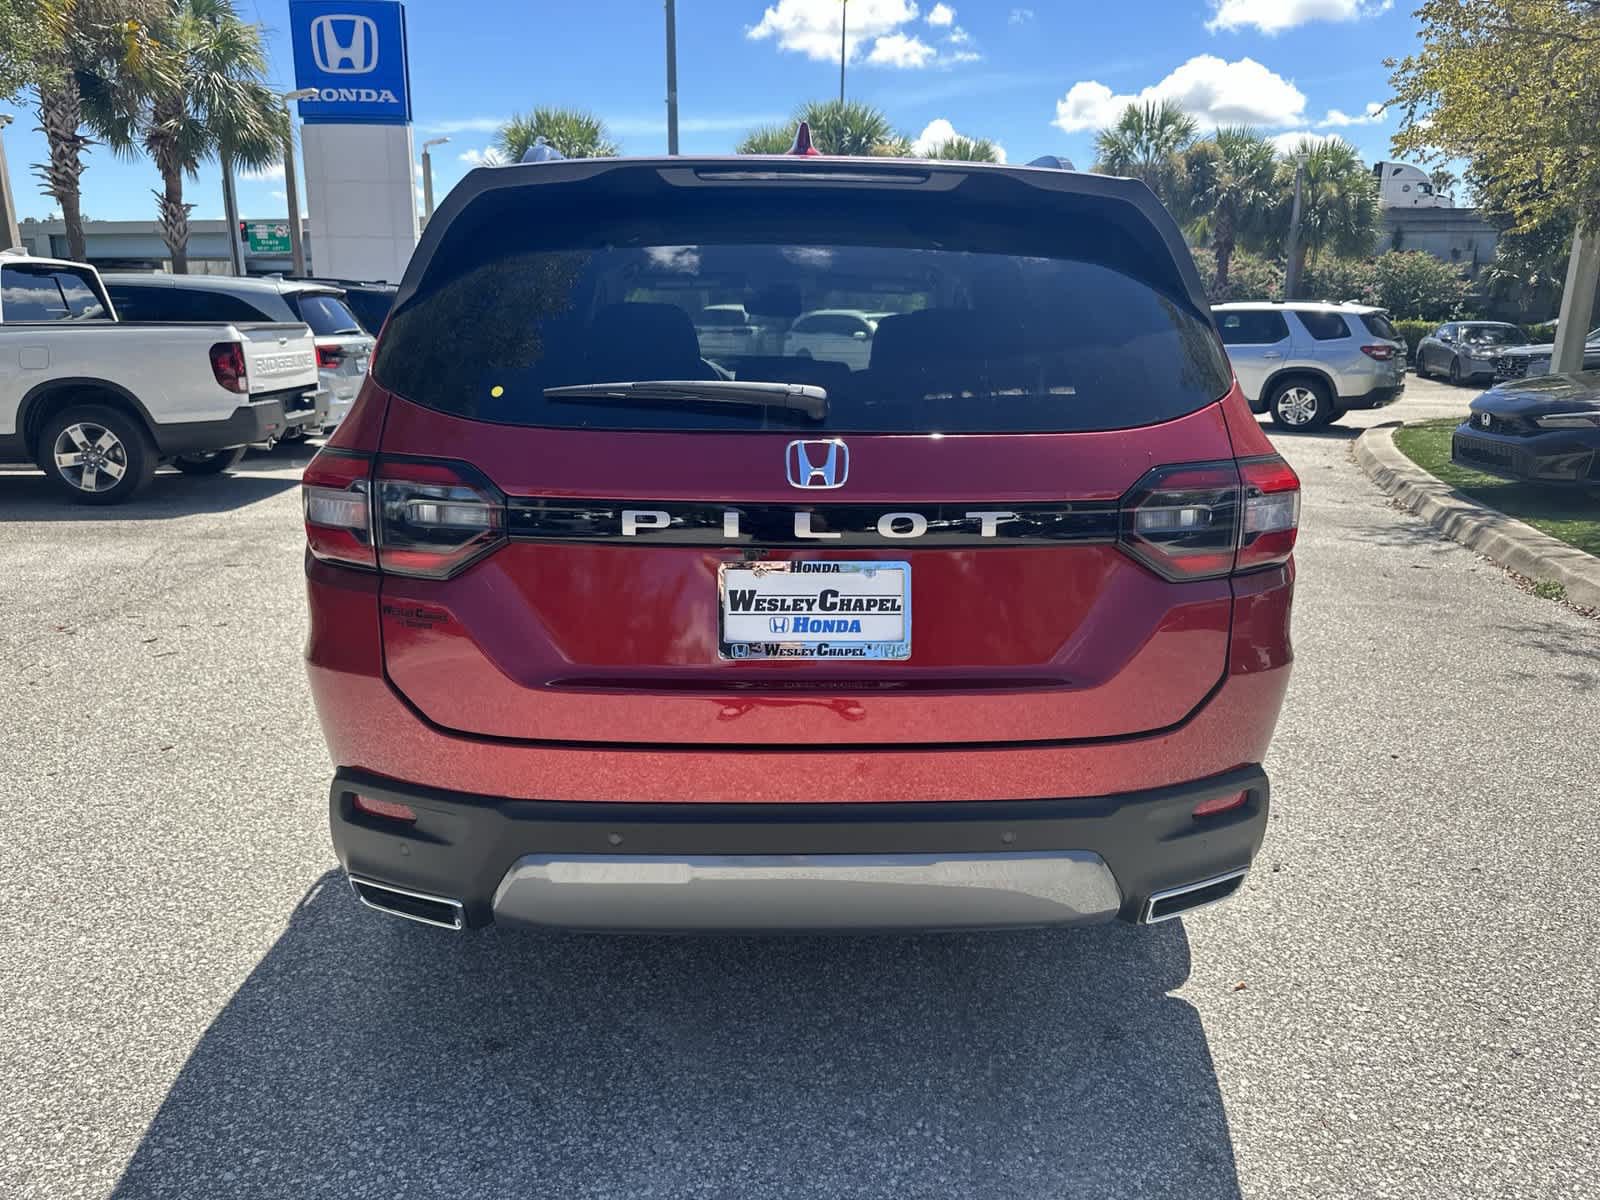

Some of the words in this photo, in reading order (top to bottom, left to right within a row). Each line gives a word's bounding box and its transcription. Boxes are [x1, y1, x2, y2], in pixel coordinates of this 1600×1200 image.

[621, 509, 1018, 538] PILOT
[790, 560, 840, 573] HONDA
[728, 589, 817, 612] WESLEY
[818, 589, 902, 612] CHAPEL
[792, 617, 861, 633] HONDA
[764, 643, 816, 657] WESLEY
[816, 642, 866, 657] CHAPEL
